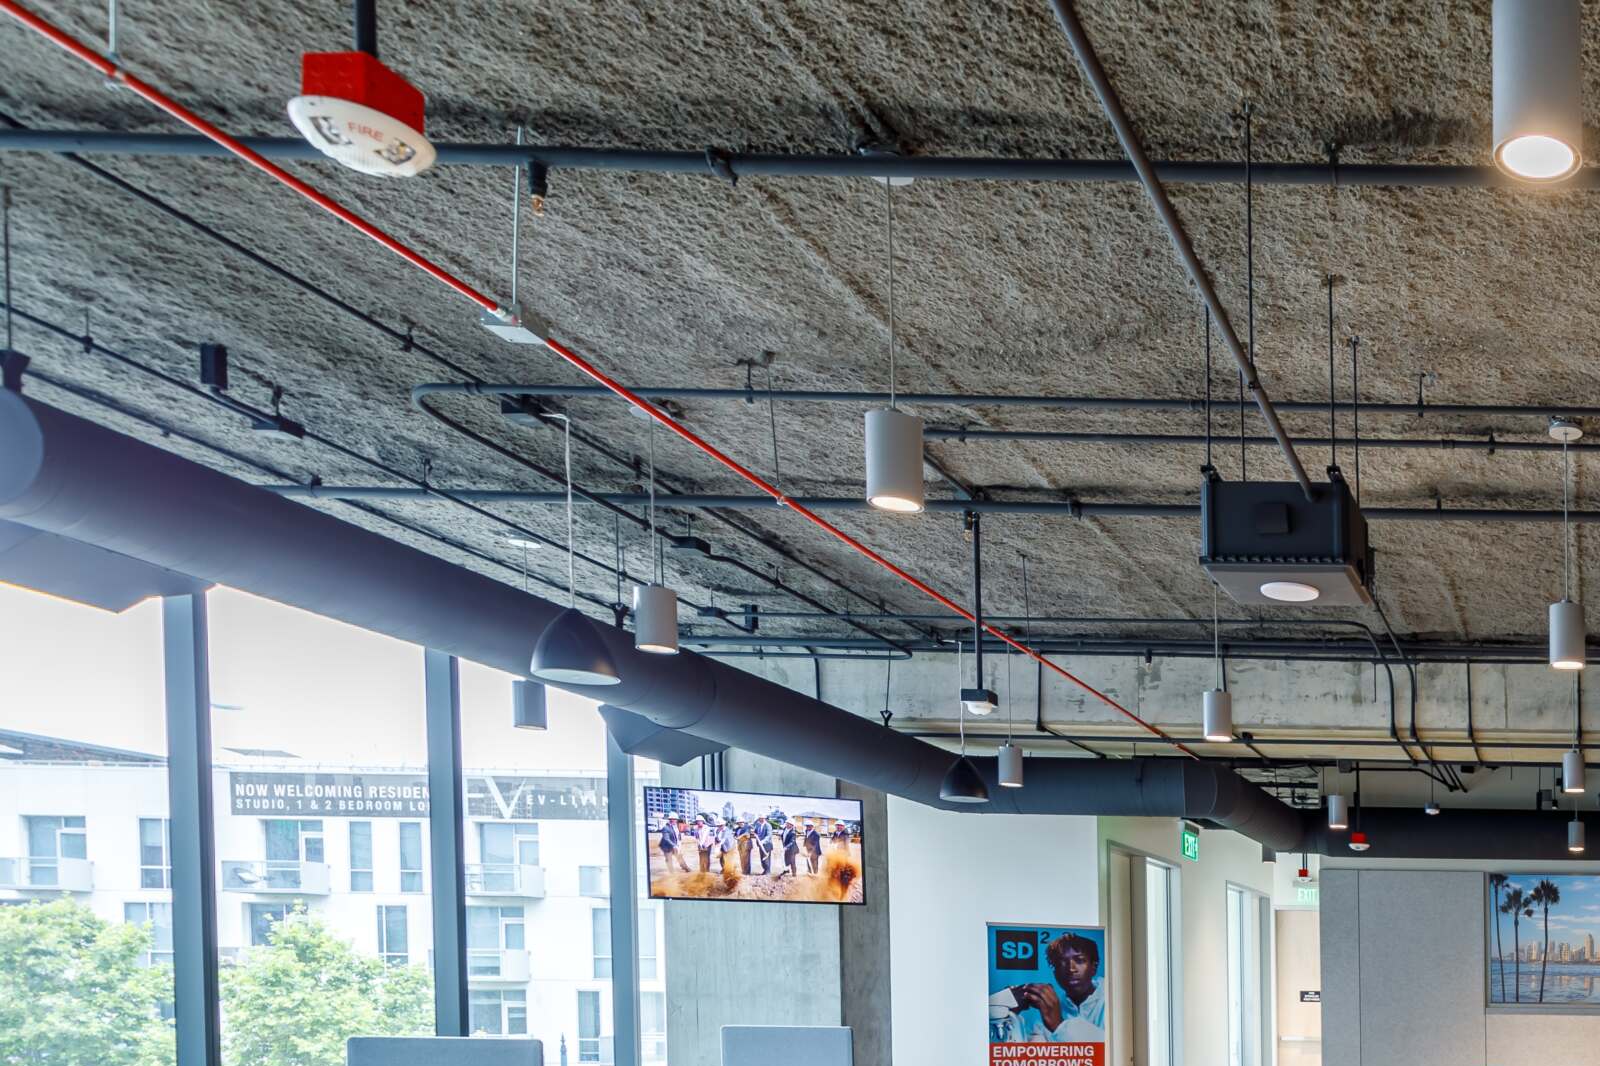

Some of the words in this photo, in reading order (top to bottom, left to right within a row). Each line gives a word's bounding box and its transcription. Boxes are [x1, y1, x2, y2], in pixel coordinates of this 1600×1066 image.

[348, 122, 384, 142] FIRE
[235, 783, 268, 797] NOW
[273, 784, 363, 798] WELCOMING
[368, 786, 430, 799] RESIDEN
[235, 799, 291, 811] STUDIO,
[297, 800, 302, 810] 1
[310, 800, 319, 810] &
[325, 800, 332, 810] 2
[339, 800, 403, 811] BEDROOM
[409, 801, 430, 812] LO
[1002, 941, 1034, 960] SD
[993, 1045, 1094, 1057] EMPOWERING
